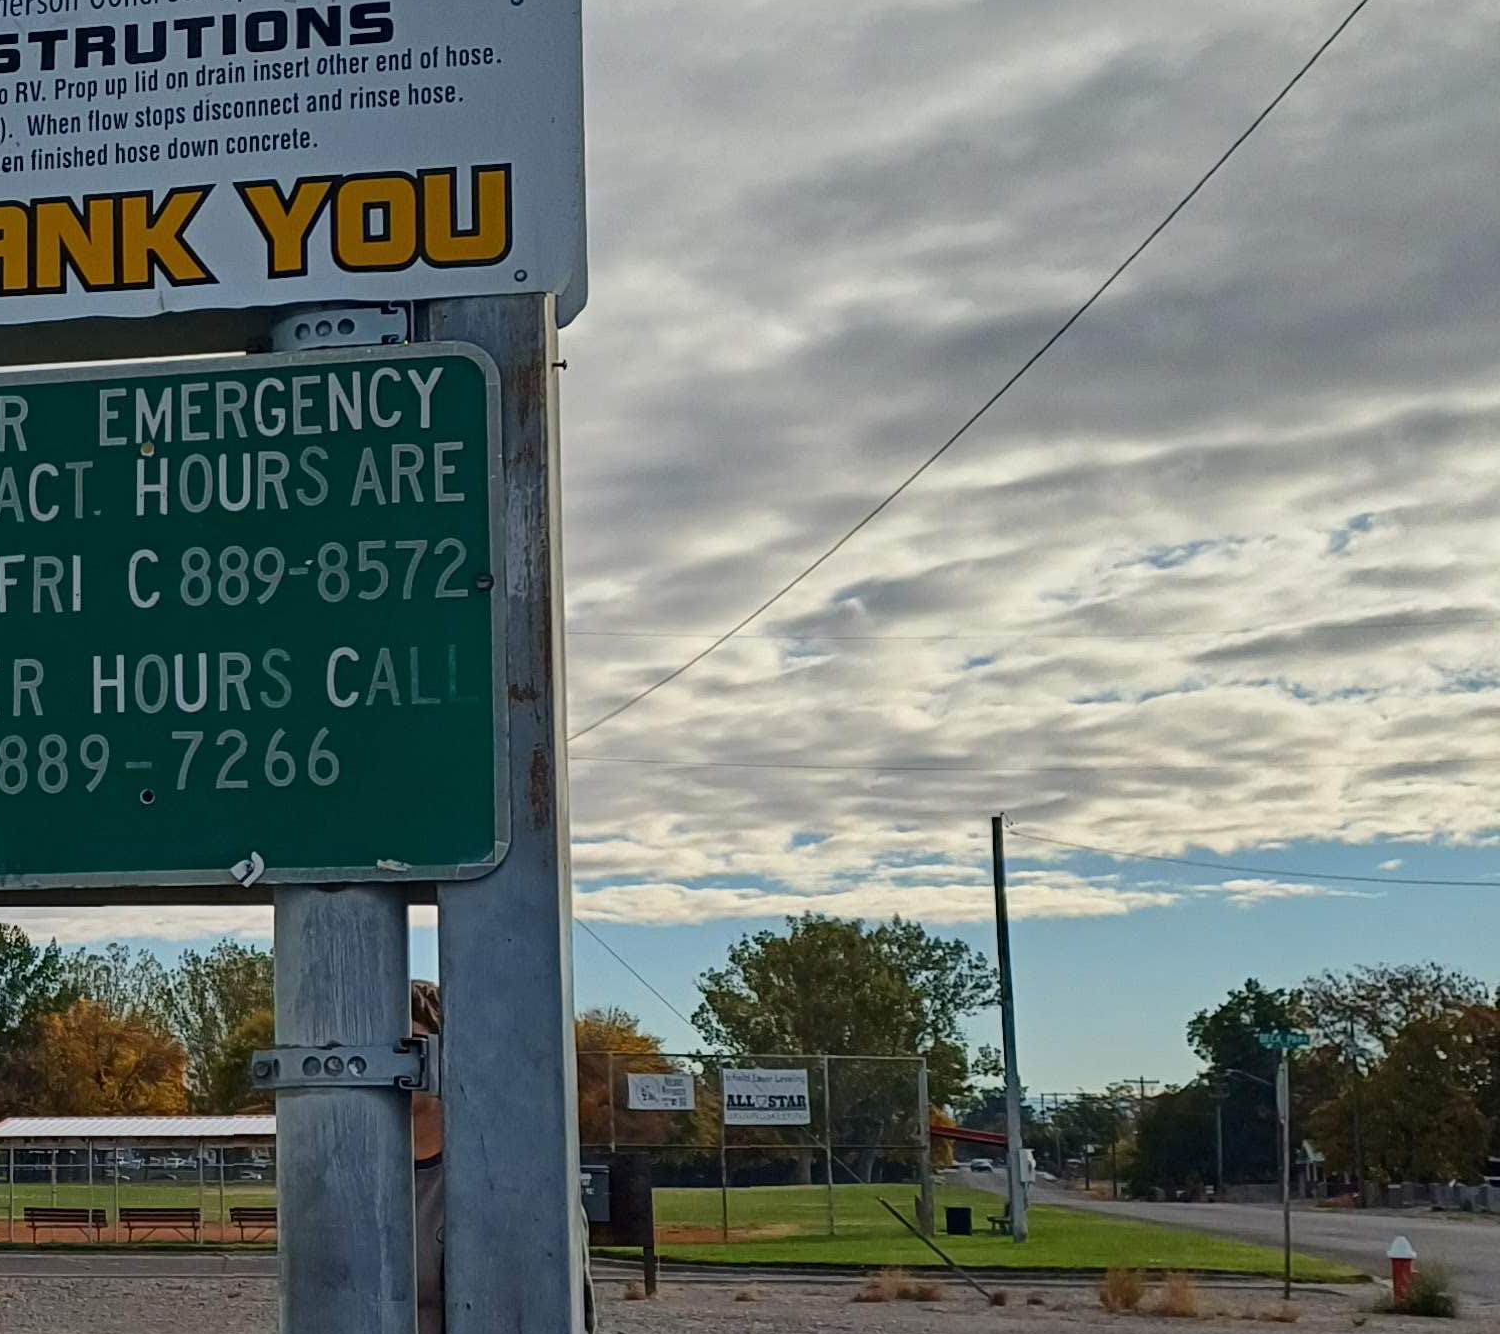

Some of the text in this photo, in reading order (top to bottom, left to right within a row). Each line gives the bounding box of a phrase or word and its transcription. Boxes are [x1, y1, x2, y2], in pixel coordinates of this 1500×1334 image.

[16, 80, 46, 104] RV.
[55, 77, 98, 102] Prop
[105, 77, 127, 97] up
[135, 71, 158, 92] lid
[166, 70, 189, 90] on
[195, 64, 245, 87] drain
[253, 56, 310, 81] insert
[316, 50, 369, 76] other
[376, 48, 412, 72] end
[420, 46, 438, 69] of
[446, 44, 502, 67] hose.
[28, 114, 81, 137] When
[88, 108, 128, 131] flow
[135, 100, 185, 128] stops
[193, 92, 299, 123] disconnect
[307, 89, 342, 113] and
[350, 85, 400, 109] rinse
[408, 83, 464, 106] hose.
[31, 144, 108, 171] finished
[115, 141, 160, 164] hose
[168, 136, 219, 159] down
[226, 128, 318, 156] concrete.
[232, 163, 512, 279] YOU
[99, 368, 443, 446] EMERGENCY
[136, 447, 328, 516] HOURS
[351, 442, 465, 506] ARE
[128, 549, 160, 609] C
[180, 538, 468, 606] 889-8572
[92, 648, 291, 714] HOURS
[726, 1094, 807, 1108] ALL STAR
